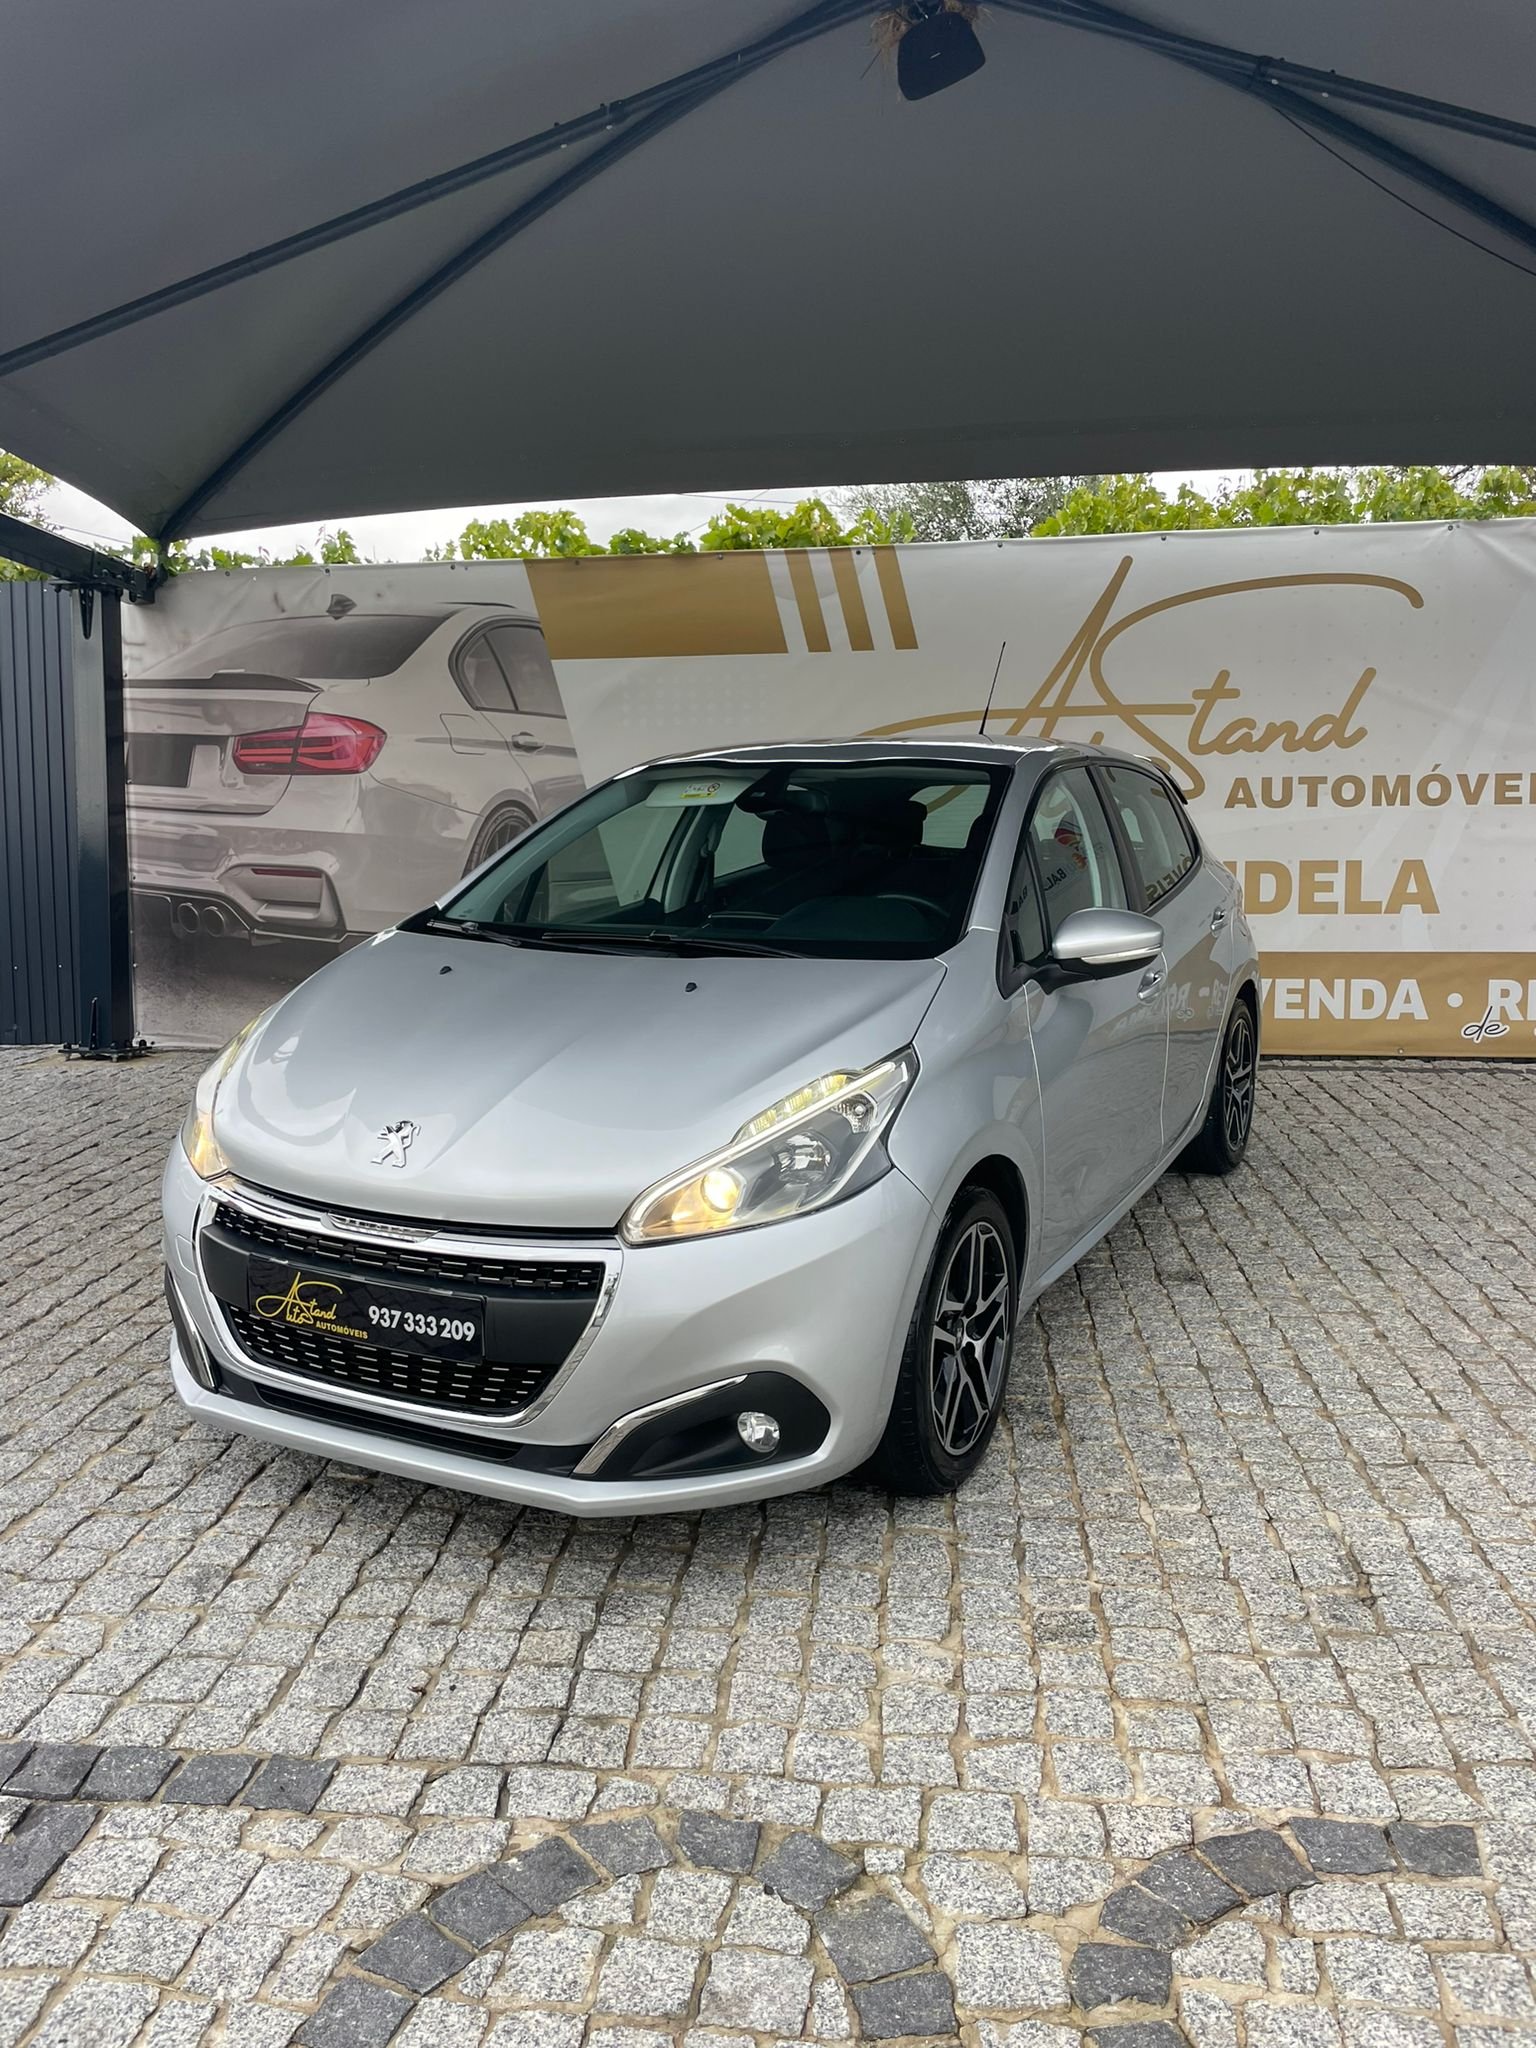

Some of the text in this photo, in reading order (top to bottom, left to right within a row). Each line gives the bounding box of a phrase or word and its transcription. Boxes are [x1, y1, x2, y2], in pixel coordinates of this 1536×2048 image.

[1462, 1005, 1509, 1042] de
[315, 1320, 369, 1340] AUTOMÓVEIS
[368, 1305, 475, 1341] 937 333 209
